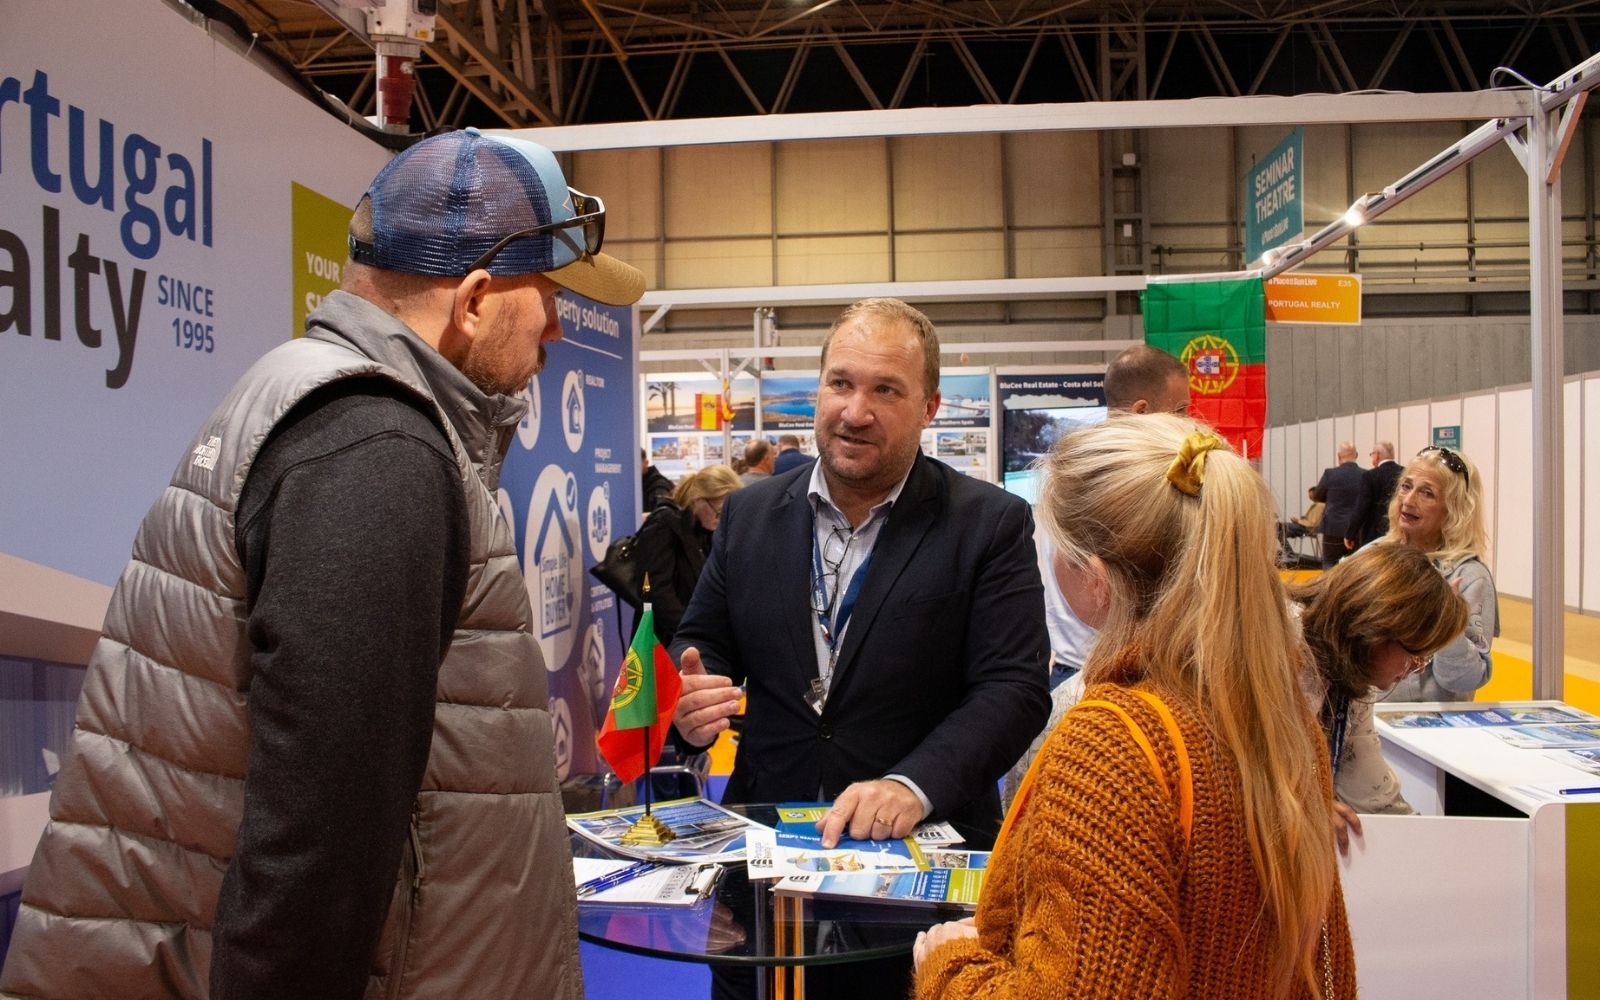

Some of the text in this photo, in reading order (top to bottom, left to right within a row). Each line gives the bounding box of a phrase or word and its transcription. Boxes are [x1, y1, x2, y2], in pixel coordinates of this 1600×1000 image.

[1255, 146, 1295, 198] SEMINAR
[1255, 174, 1296, 224] THEATRE
[305, 251, 341, 284] YOUR
[157, 274, 214, 318] SINCE
[1268, 300, 1341, 310] PORTUGAL REALTY
[171, 317, 215, 354] 1995
[582, 305, 620, 339] solution
[545, 574, 565, 600] HOME
[545, 599, 566, 626] BUYER
